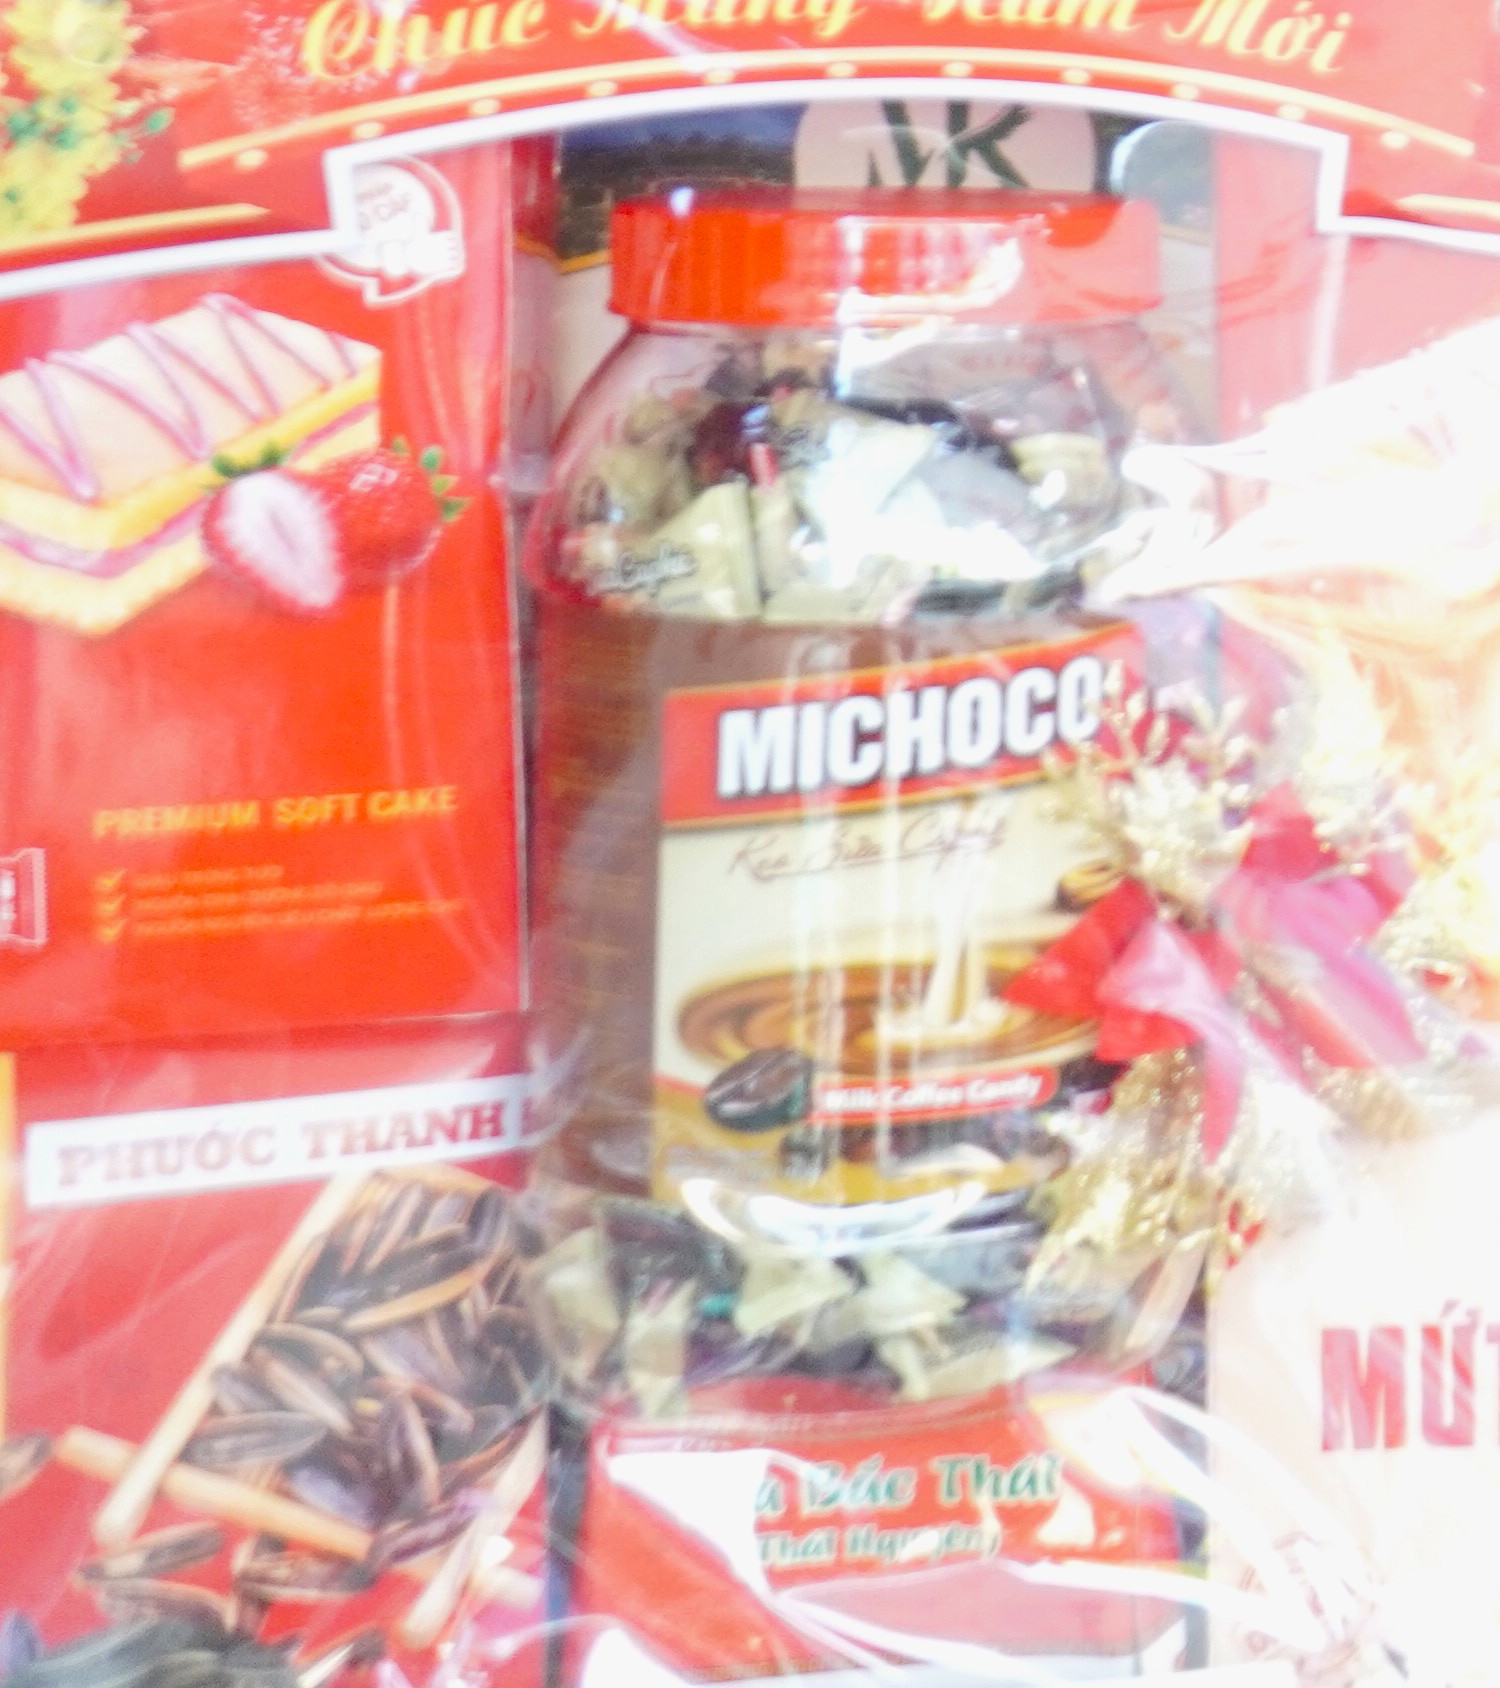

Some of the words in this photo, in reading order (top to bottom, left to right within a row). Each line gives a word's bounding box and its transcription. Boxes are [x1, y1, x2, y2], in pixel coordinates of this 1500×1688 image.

[716, 655, 1104, 799] MICHOCO
[92, 799, 260, 840] PREMIUM
[273, 792, 362, 829] SOFT
[367, 785, 458, 820] CAKE
[965, 1071, 1044, 1102] Candy
